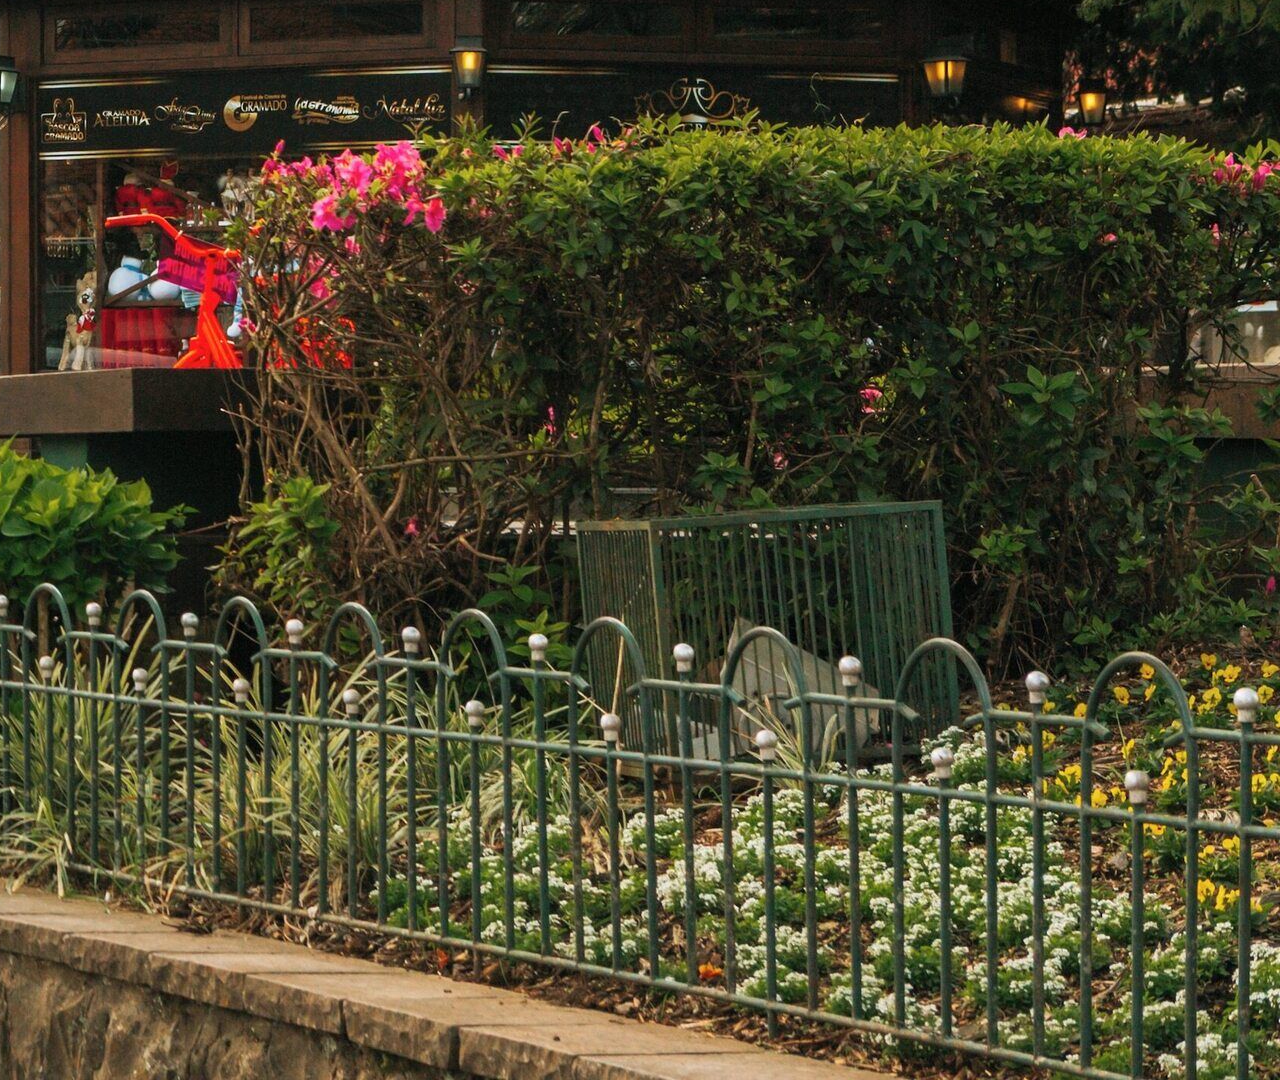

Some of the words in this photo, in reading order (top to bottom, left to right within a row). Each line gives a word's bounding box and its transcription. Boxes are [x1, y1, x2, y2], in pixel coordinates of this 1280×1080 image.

[240, 99, 288, 112] GRAMADO
[372, 94, 422, 117] Natal
[94, 111, 151, 128] ALELUIA
[102, 109, 141, 117] GRAMADO
[44, 132, 84, 142] GRAMADO
